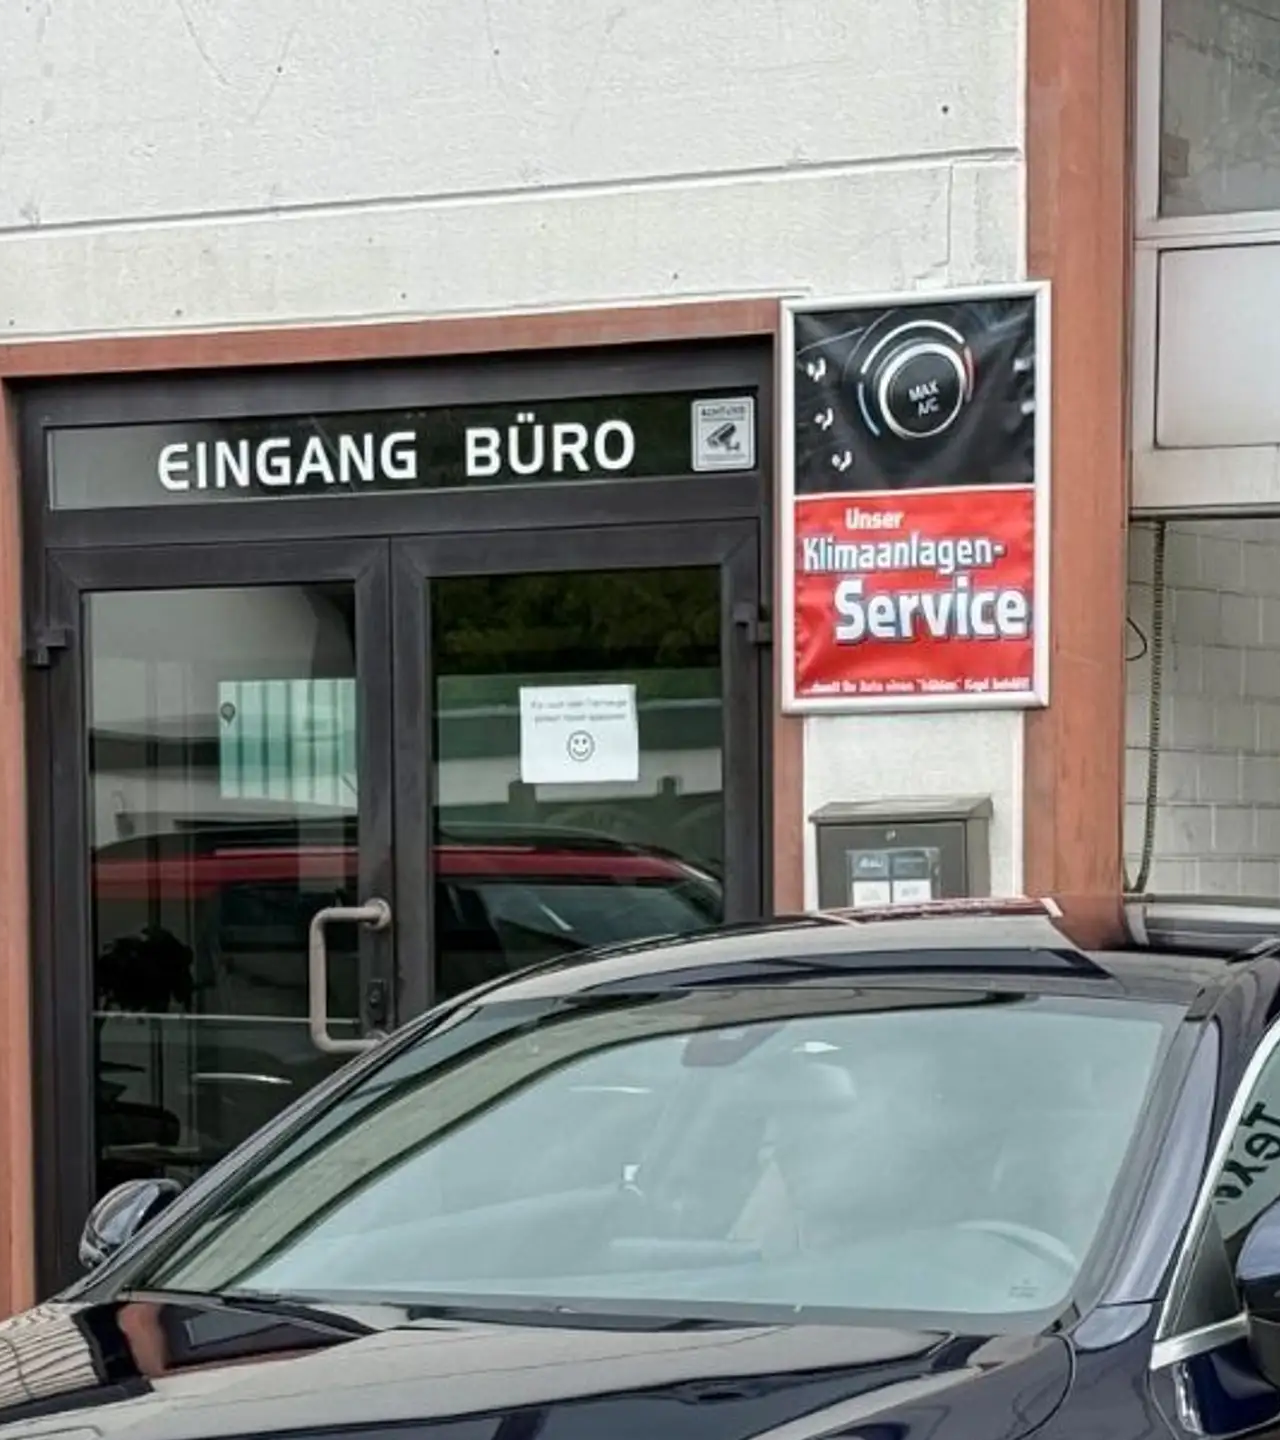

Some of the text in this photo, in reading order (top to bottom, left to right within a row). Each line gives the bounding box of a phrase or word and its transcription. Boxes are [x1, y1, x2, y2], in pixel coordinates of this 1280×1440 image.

[908, 379, 940, 402] MAX
[158, 412, 635, 490] EINGANG BÜRO
[845, 508, 904, 530] Unser
[802, 532, 1006, 574] Klimaanlagen-
[833, 576, 1029, 642] Service
